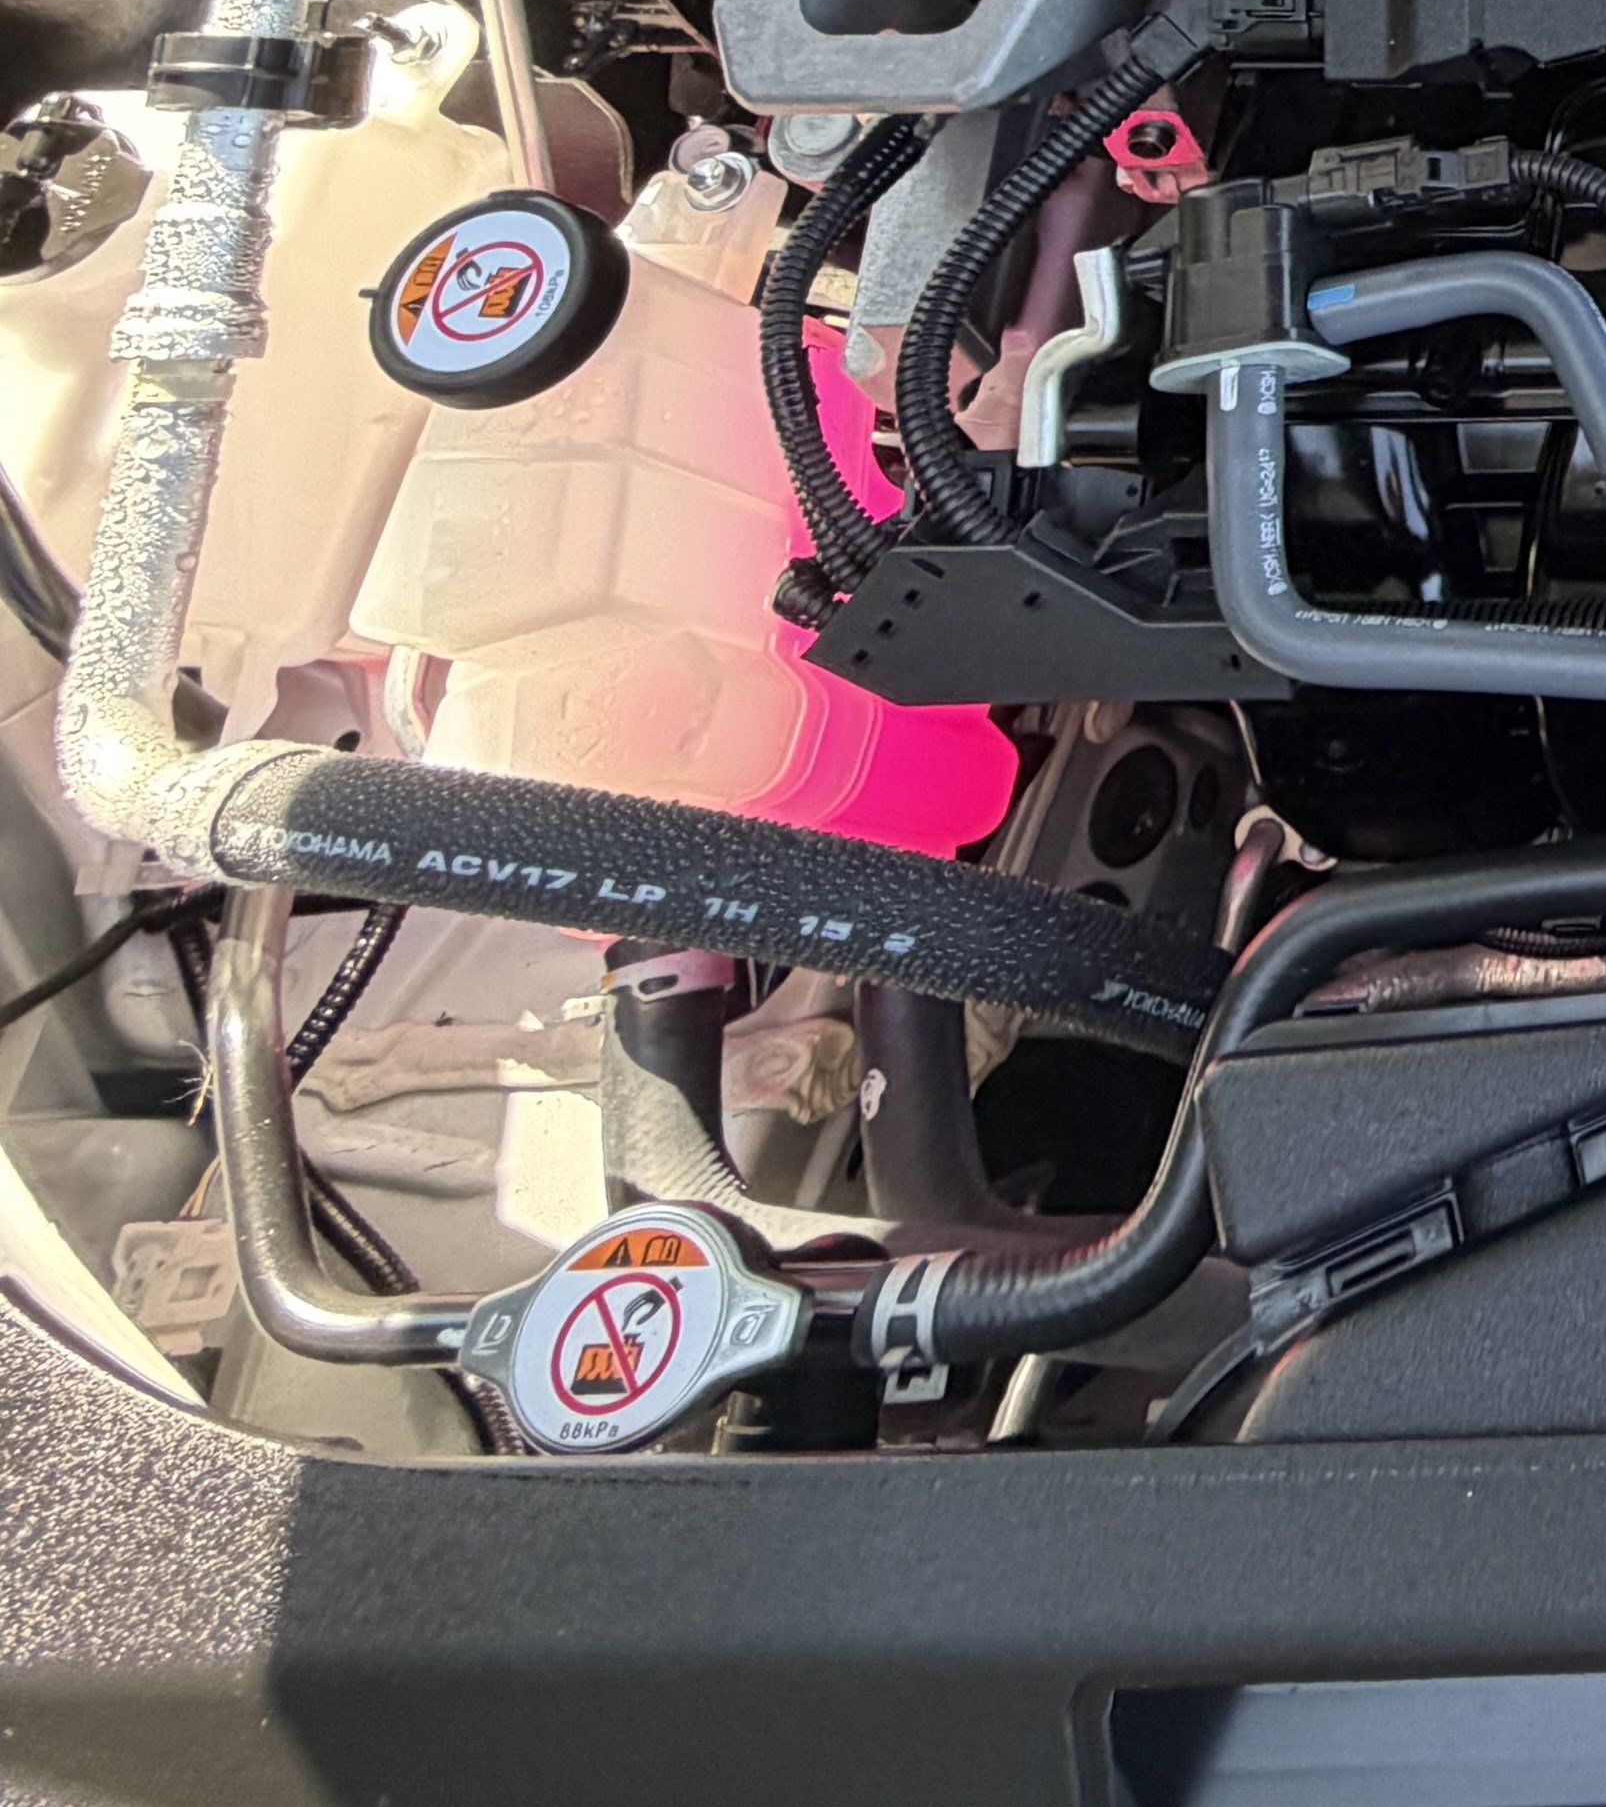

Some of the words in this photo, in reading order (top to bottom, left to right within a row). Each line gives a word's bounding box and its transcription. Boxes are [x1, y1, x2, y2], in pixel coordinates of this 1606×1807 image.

[416, 850, 579, 890] ACV17
[597, 877, 667, 904] LP
[559, 1420, 620, 1440] 88kPa
